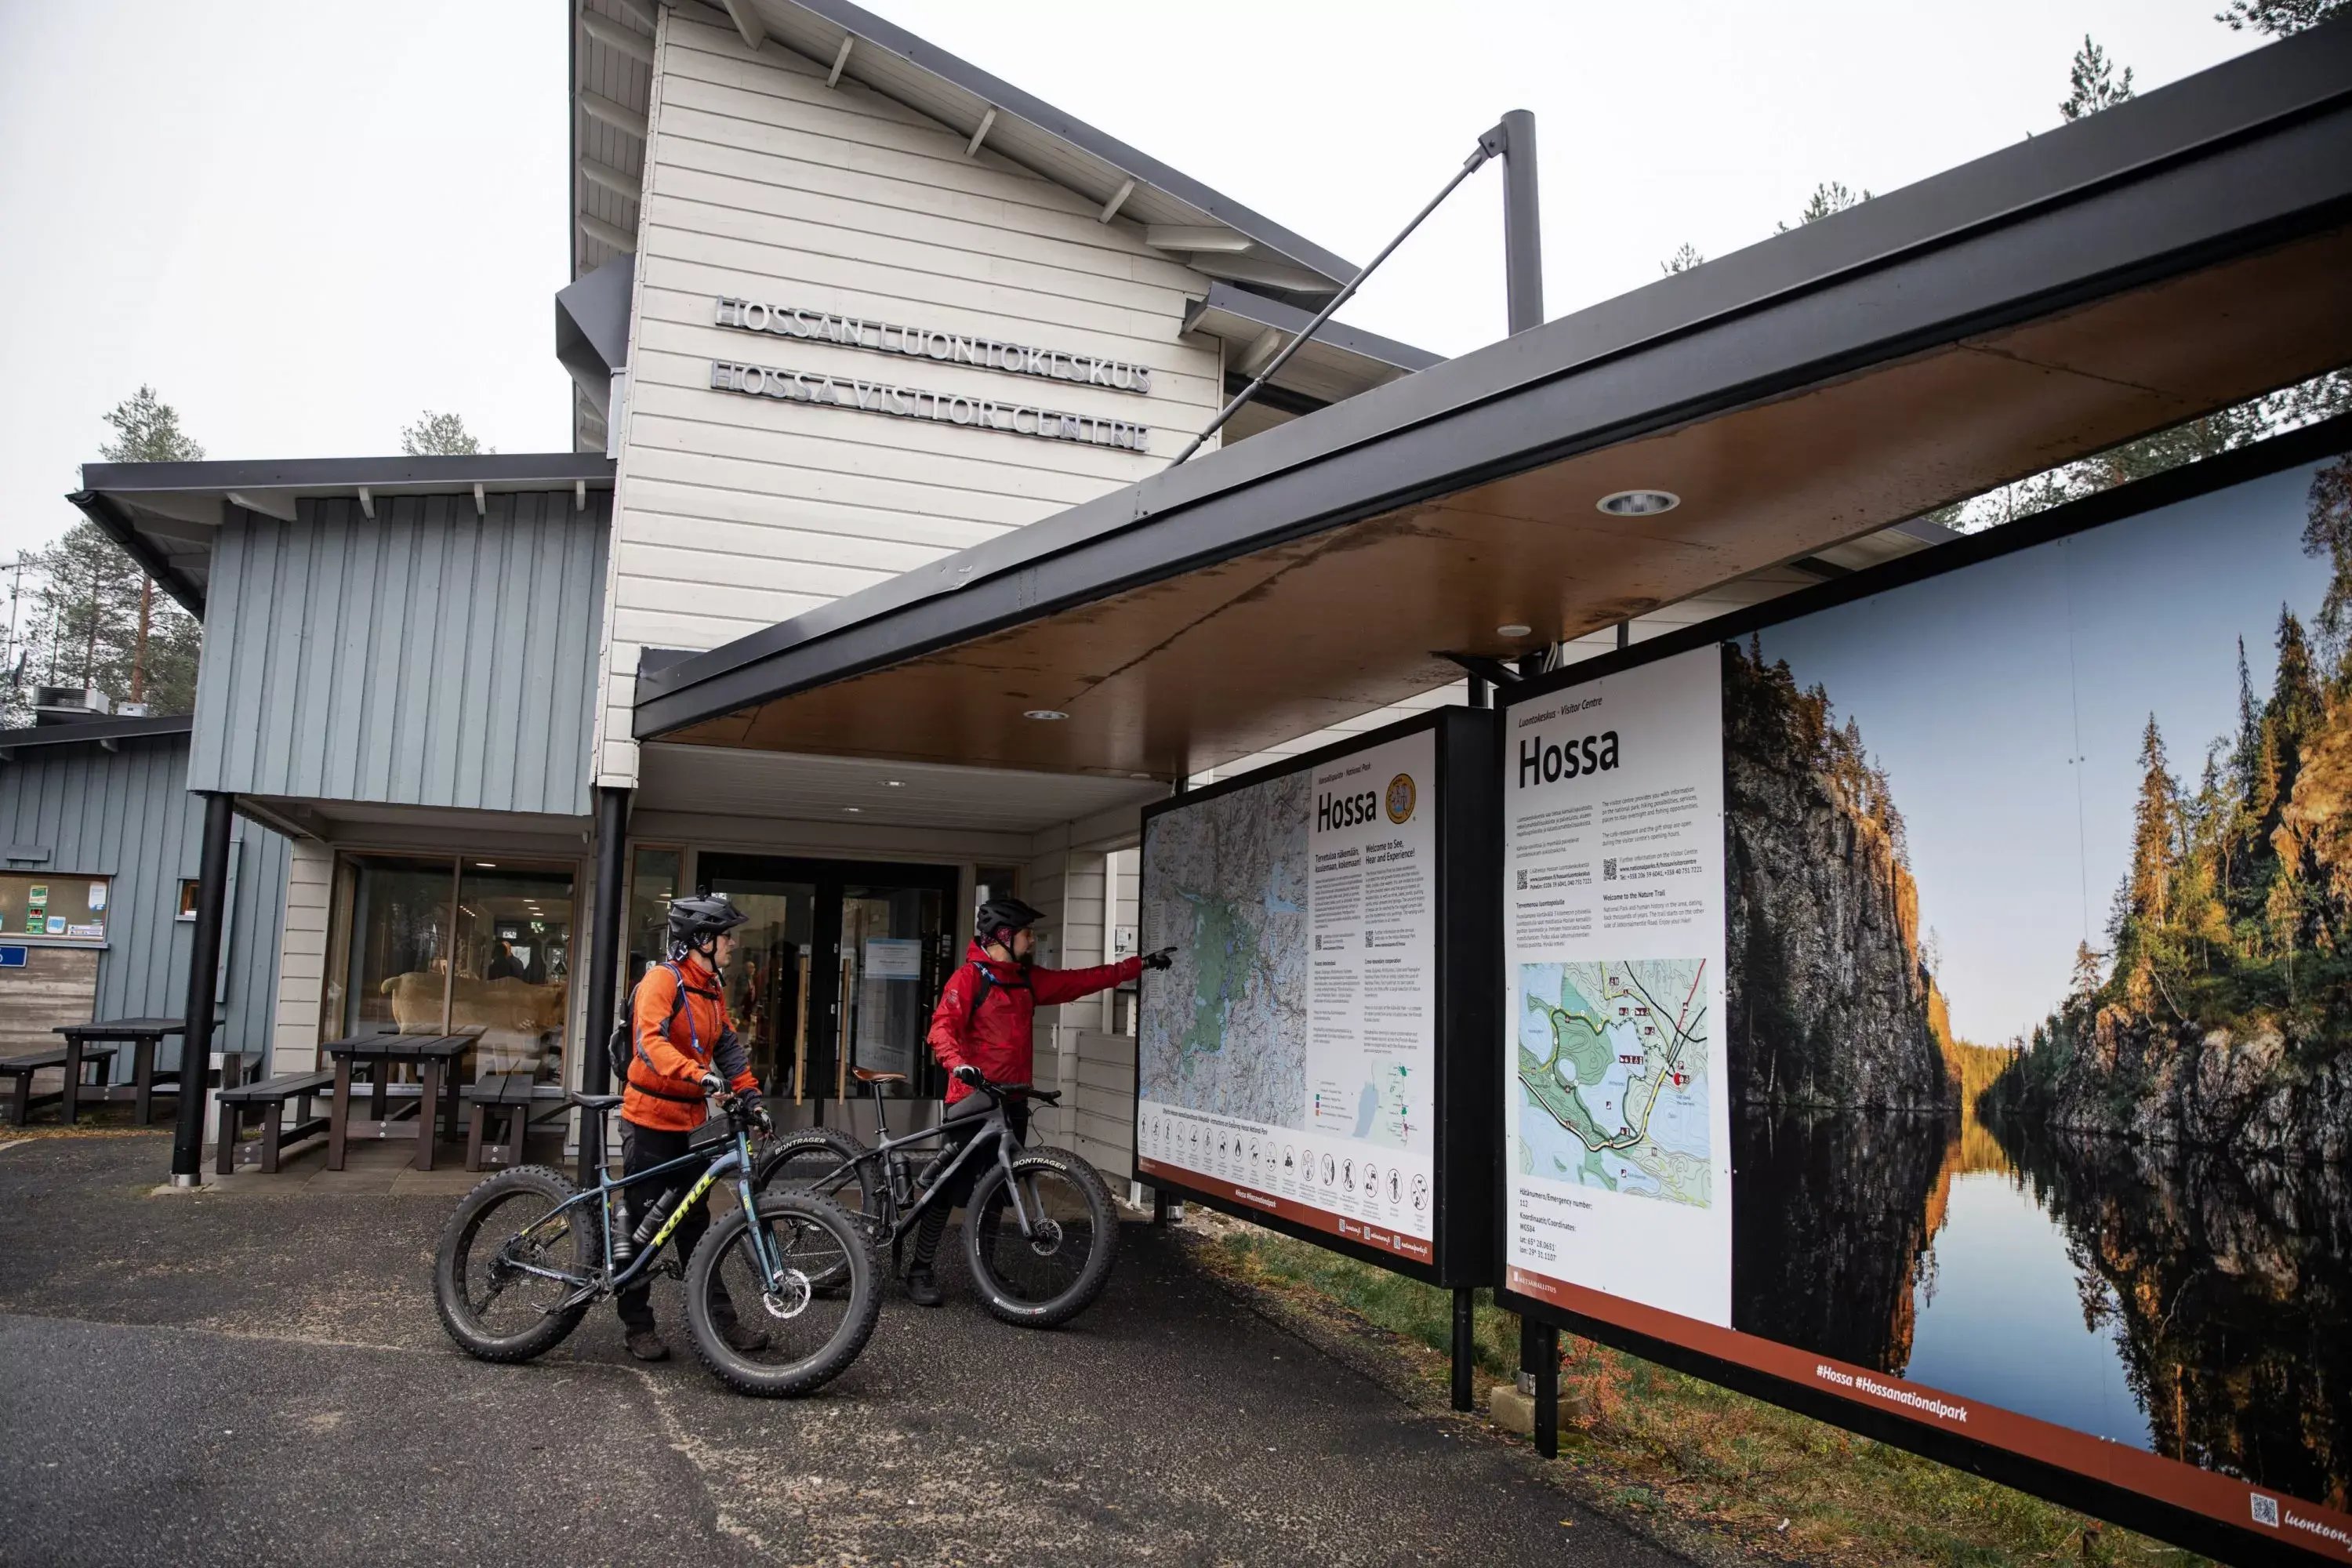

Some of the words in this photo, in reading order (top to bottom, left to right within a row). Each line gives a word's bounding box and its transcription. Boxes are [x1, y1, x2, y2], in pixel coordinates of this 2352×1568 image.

[714, 295, 862, 347] HOSSAN
[878, 320, 1152, 394] LUONTOKESKUS
[710, 358, 838, 406] HOSSA
[853, 378, 997, 429] VISITOR
[1013, 404, 1151, 453] CENTRE
[1519, 710, 1556, 728] Luontokeskus
[1561, 702, 1581, 716] Visitor
[1581, 697, 1602, 710] Centre
[1519, 730, 1620, 789] Hossa
[1317, 790, 1377, 833] Hossa
[1365, 842, 1387, 854] Welcome
[1393, 839, 1404, 848] See,
[1365, 855, 1376, 865] Hear
[1377, 854, 1386, 863] and
[1386, 847, 1416, 862] Experience!
[775, 1137, 826, 1155] BONTRAGER
[1012, 1157, 1067, 1171] BONTRAGER
[1519, 1211, 1577, 1232] Koordinaatit/Coordinates:
[1519, 1223, 1535, 1233] WGS84
[1519, 1246, 1528, 1254] lon:
[1816, 1363, 1853, 1387] #Hossa
[1855, 1375, 1968, 1423] #Hossanationalpark
